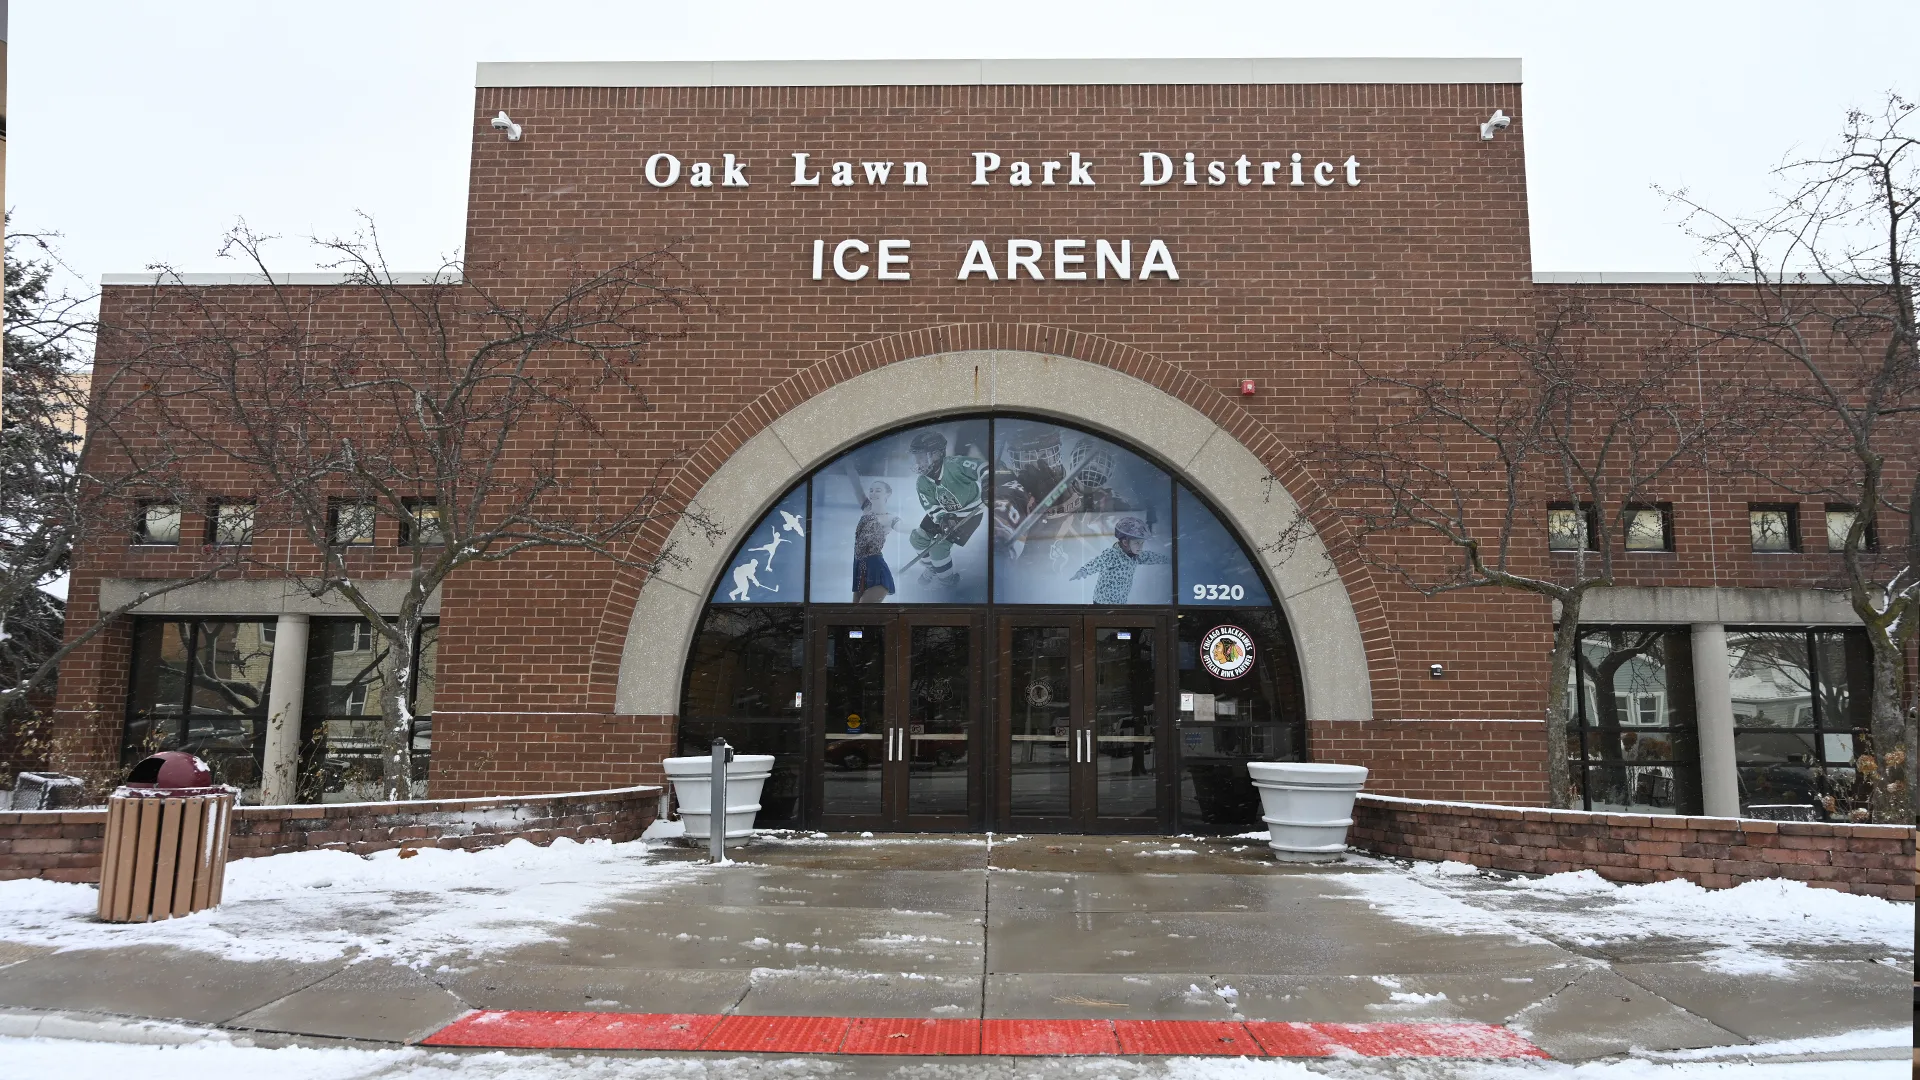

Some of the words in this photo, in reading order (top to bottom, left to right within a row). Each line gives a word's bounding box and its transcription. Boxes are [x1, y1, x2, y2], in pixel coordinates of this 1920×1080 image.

[644, 152, 750, 188] Oak
[790, 152, 929, 187] Lawn
[970, 152, 1096, 187] Park
[1138, 152, 1362, 187] District
[812, 238, 912, 282] ICE
[956, 238, 1180, 281] ARENA
[1193, 584, 1245, 600] 9320
[1202, 629, 1221, 651] CHICAGO
[1220, 627, 1253, 651] BLACKHAWKS
[1203, 654, 1221, 675] OFFICIAL
[1220, 670, 1235, 678] RINK
[1234, 654, 1253, 676] PARTNER
